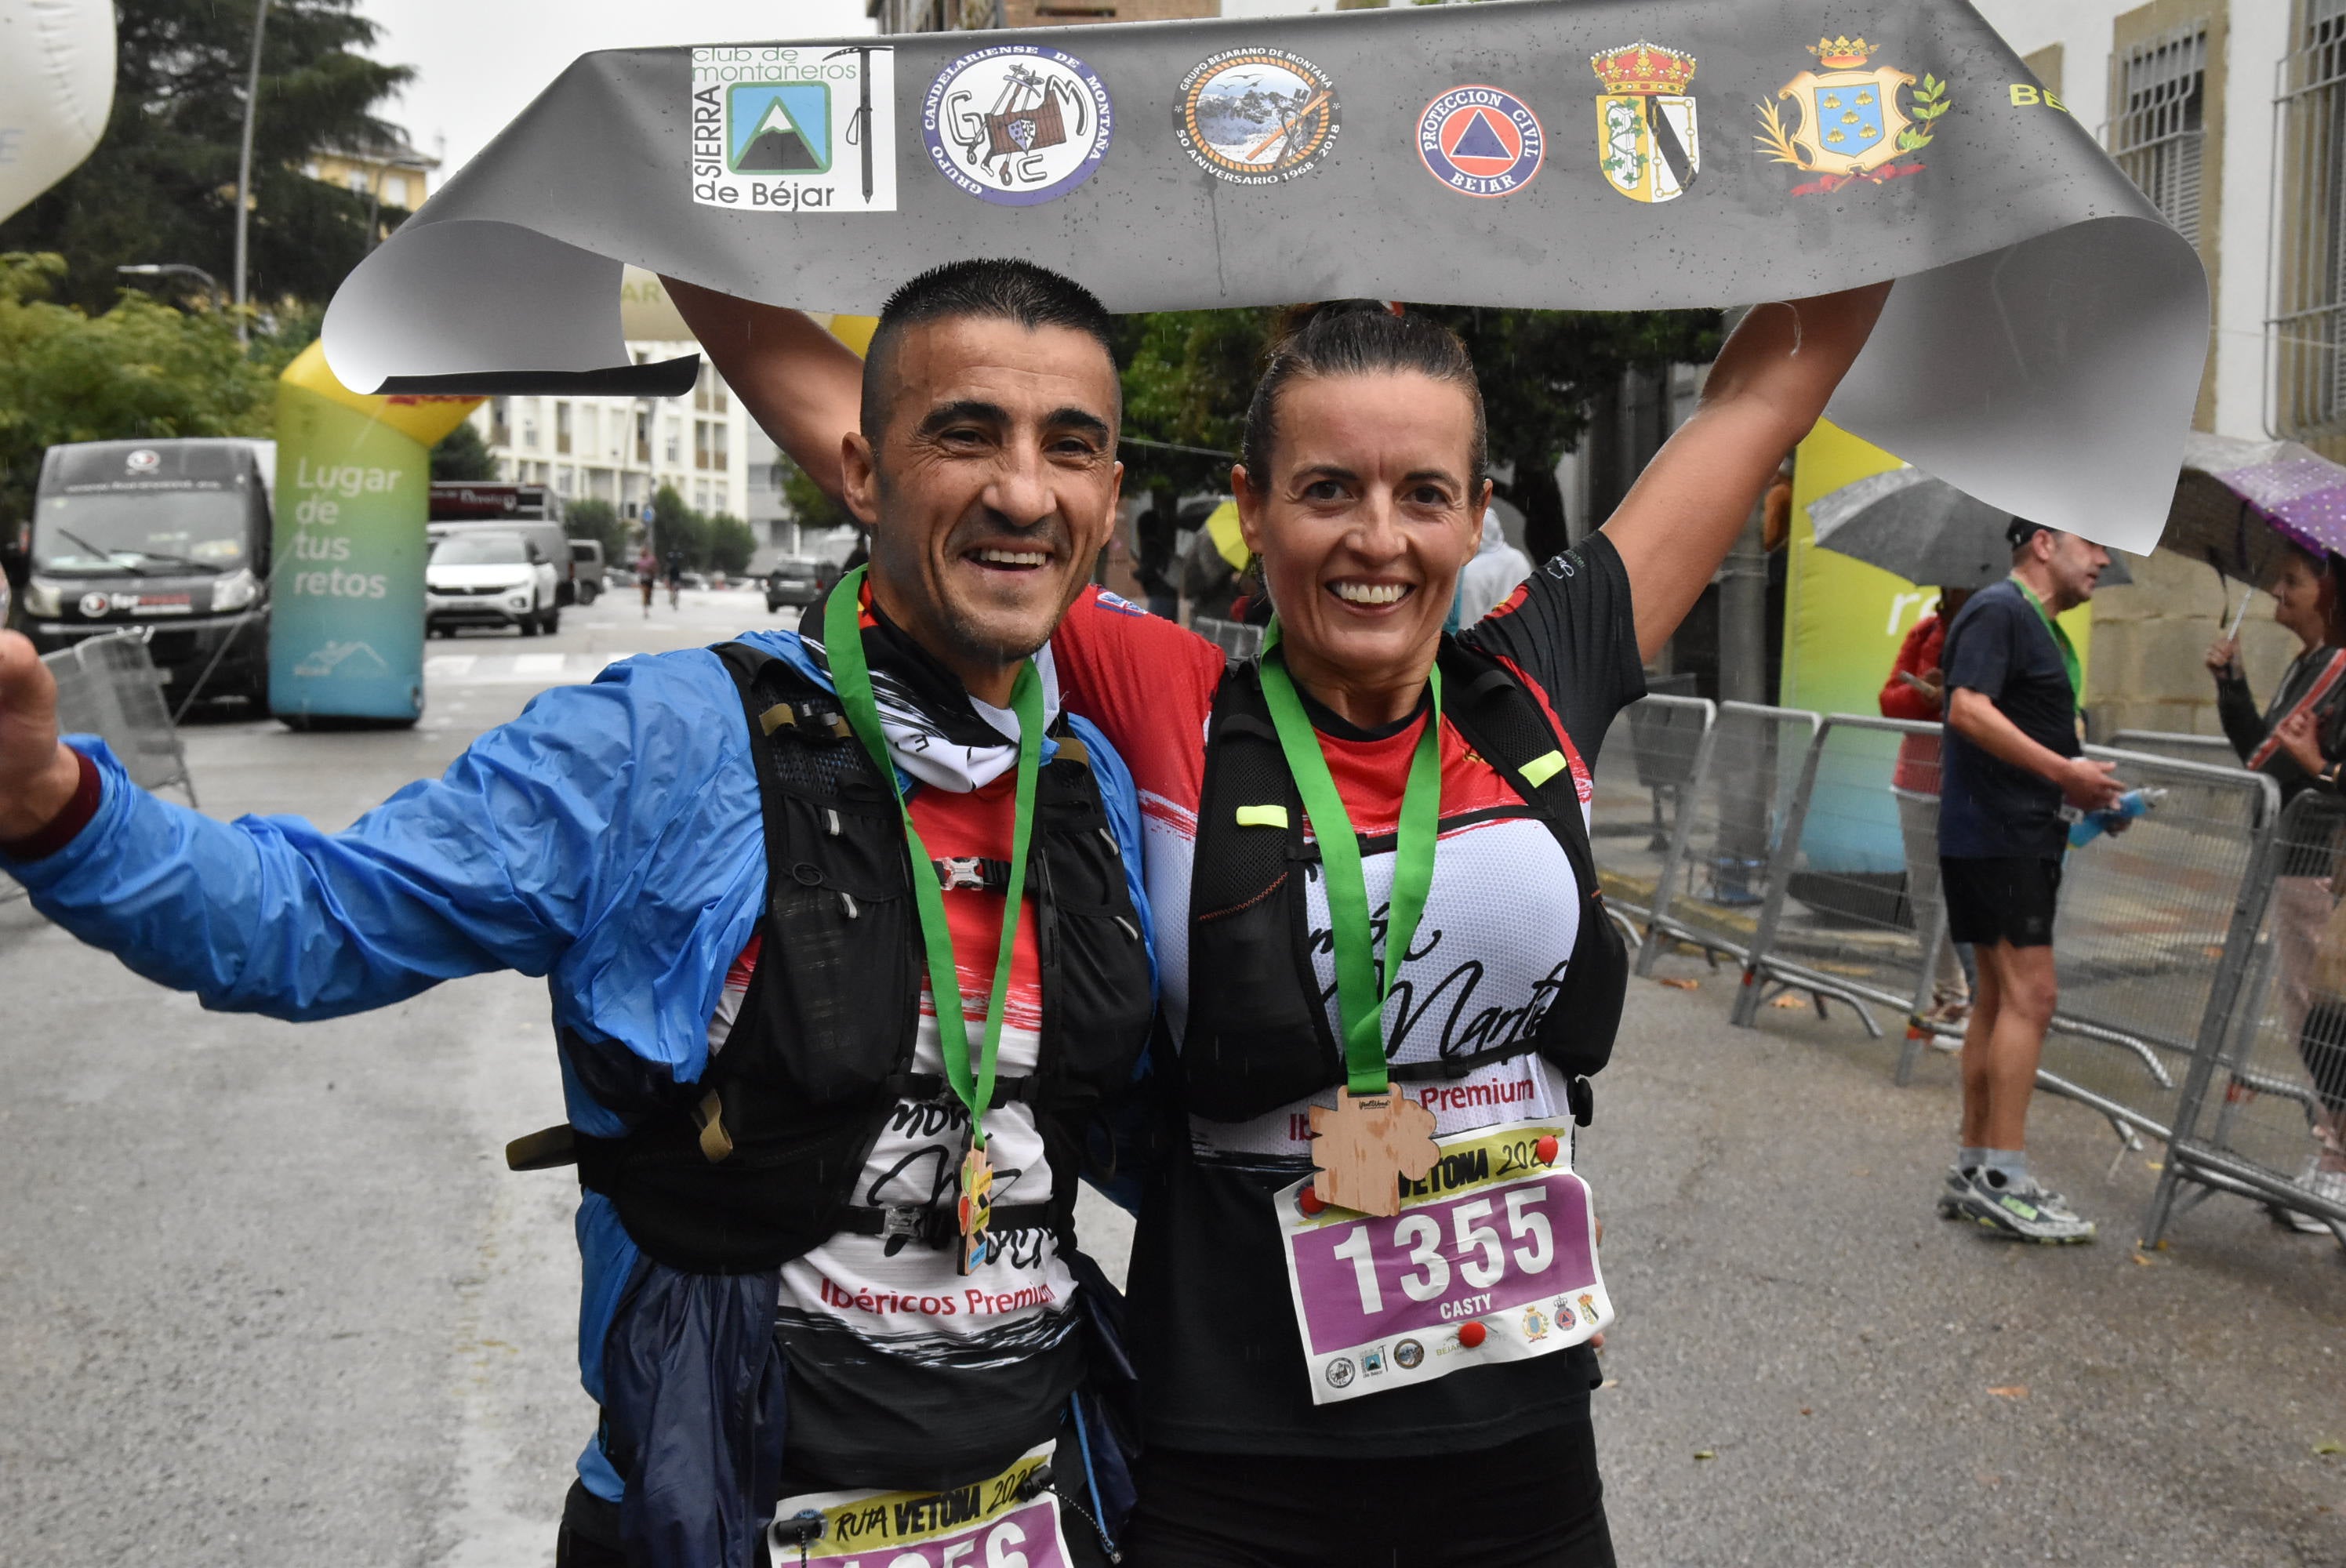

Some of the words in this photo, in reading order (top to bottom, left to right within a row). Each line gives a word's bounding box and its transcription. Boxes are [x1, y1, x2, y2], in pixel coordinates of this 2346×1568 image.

[692, 47, 752, 62] club
[762, 47, 798, 61] de
[692, 62, 856, 82] montañeros
[1180, 62, 1208, 91] GRUPO
[1207, 47, 1266, 66] BEJARANO
[1269, 48, 1284, 57] DE
[925, 45, 1039, 131] CANDELARIENSE
[1053, 52, 1080, 69] DE
[695, 85, 721, 179] SIERRA
[1422, 91, 1503, 151] PROTECCION
[1513, 109, 1539, 158] CIVIL
[932, 146, 982, 195] GRUPO
[1176, 129, 1190, 147] 50
[1187, 148, 1279, 185] ANIVERSARIO
[1282, 162, 1314, 180] 1968
[1319, 124, 1340, 158] 2018
[695, 180, 739, 204] de
[752, 180, 834, 212] Béjar
[1450, 172, 1516, 193] BEJAR
[296, 457, 402, 498] Lugar
[296, 492, 339, 525] de
[294, 531, 351, 561] tus
[294, 568, 387, 599] retos
[1419, 1077, 1534, 1112] Premium
[1495, 1134, 1557, 1176] 202
[1333, 1185, 1554, 1316] 1355
[820, 1277, 956, 1315] Ibéricos
[964, 1283, 1056, 1315] Premium
[1440, 1293, 1493, 1320] CASTY
[835, 1504, 889, 1542] RUTA
[894, 1484, 981, 1537] VETONA
